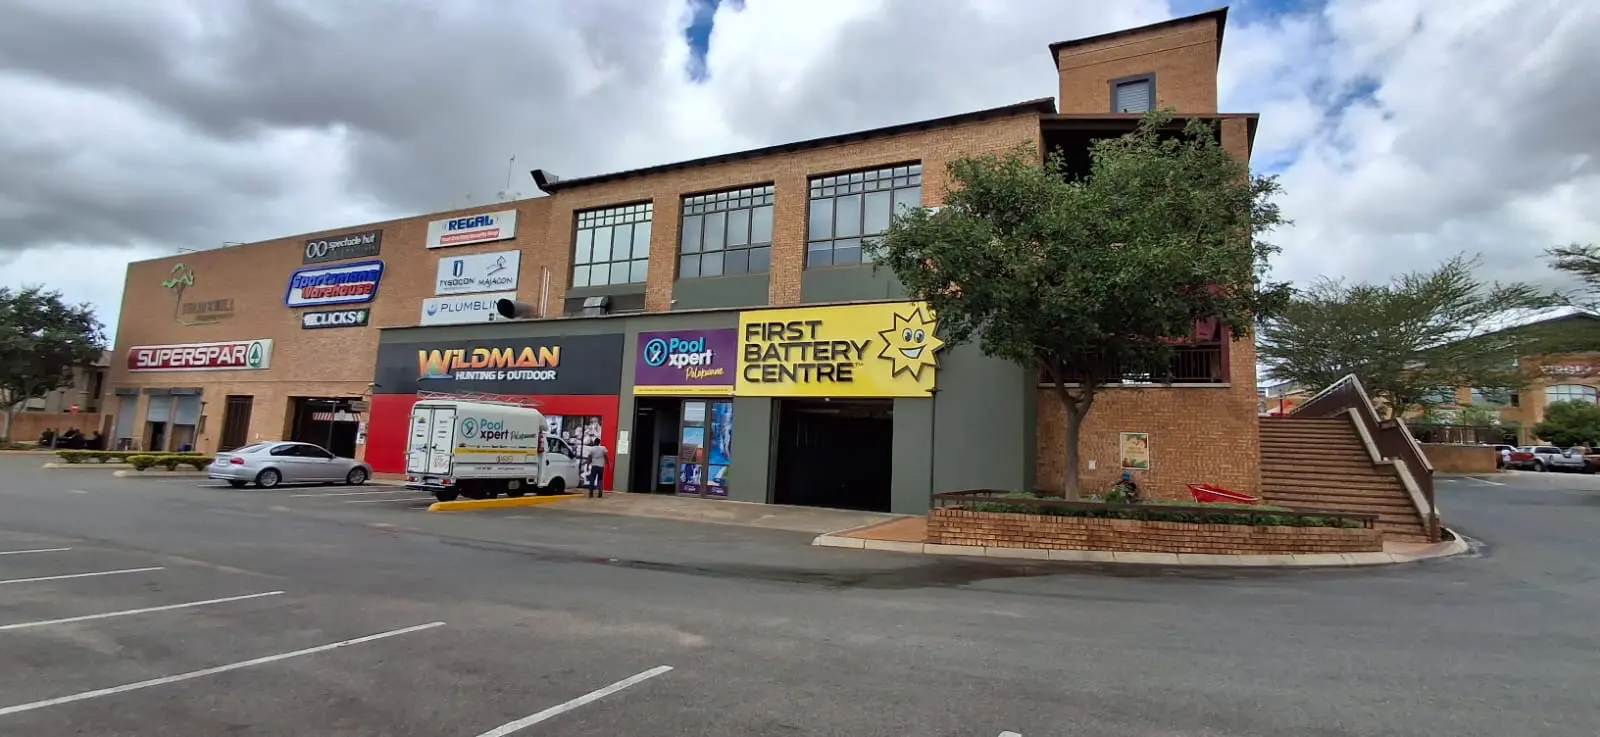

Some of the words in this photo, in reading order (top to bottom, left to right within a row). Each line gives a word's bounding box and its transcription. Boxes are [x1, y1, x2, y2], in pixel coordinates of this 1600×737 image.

[448, 215, 494, 231] REGAL
[328, 236, 361, 250] spectacle
[362, 233, 375, 244] hut
[302, 283, 374, 299] Warehouse
[304, 311, 357, 326] CLICKS
[745, 320, 822, 342] FIRST
[670, 336, 705, 353] Pool
[744, 340, 872, 363] BATTERY
[137, 346, 246, 367] SUPERSPAR
[669, 349, 713, 368] xpert
[455, 370, 497, 381] HUNTING
[497, 370, 506, 380] &
[506, 370, 557, 381] OUTDOOR
[480, 418, 504, 430] Pool
[480, 428, 509, 441] xpert
